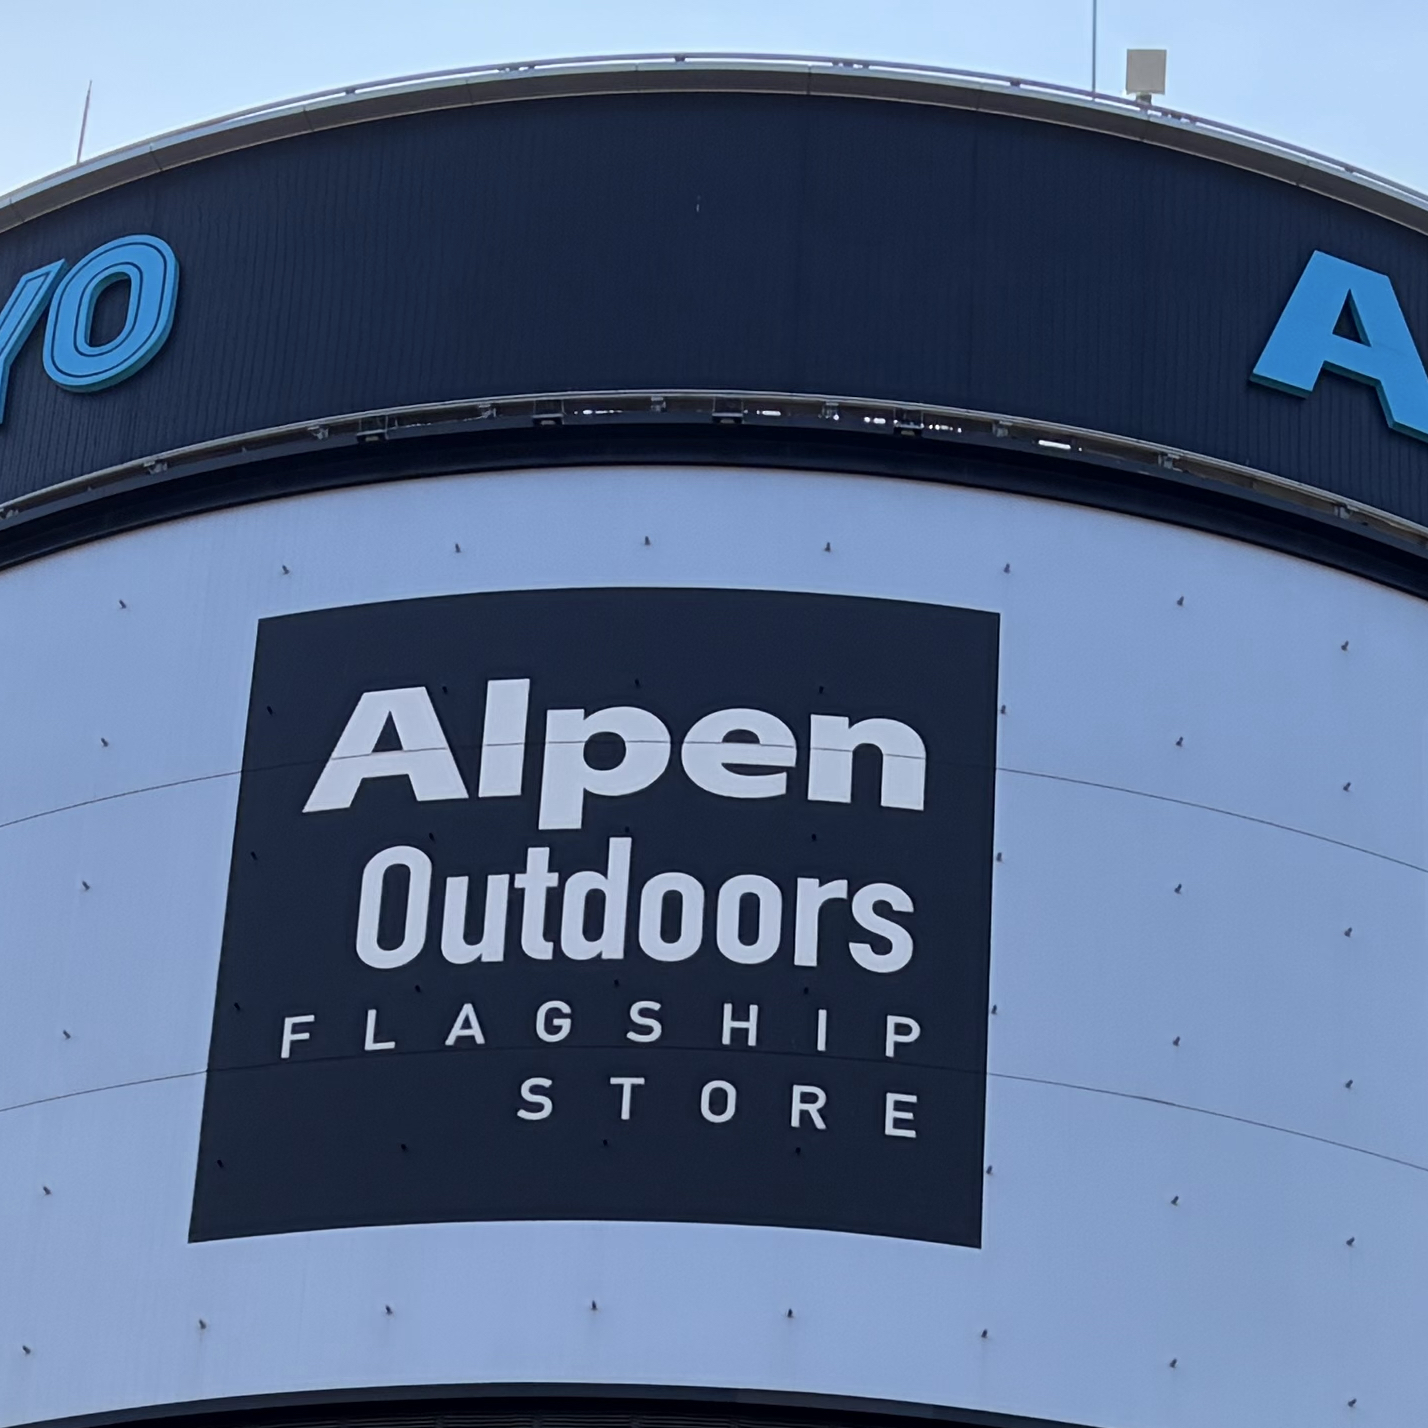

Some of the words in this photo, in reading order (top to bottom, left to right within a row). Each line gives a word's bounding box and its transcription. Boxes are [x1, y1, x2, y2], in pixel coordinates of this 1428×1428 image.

[301, 678, 927, 830] Alpen
[355, 836, 916, 974] Outdoors
[280, 999, 922, 1060] FLAGSHIP
[516, 1076, 919, 1140] STORE
